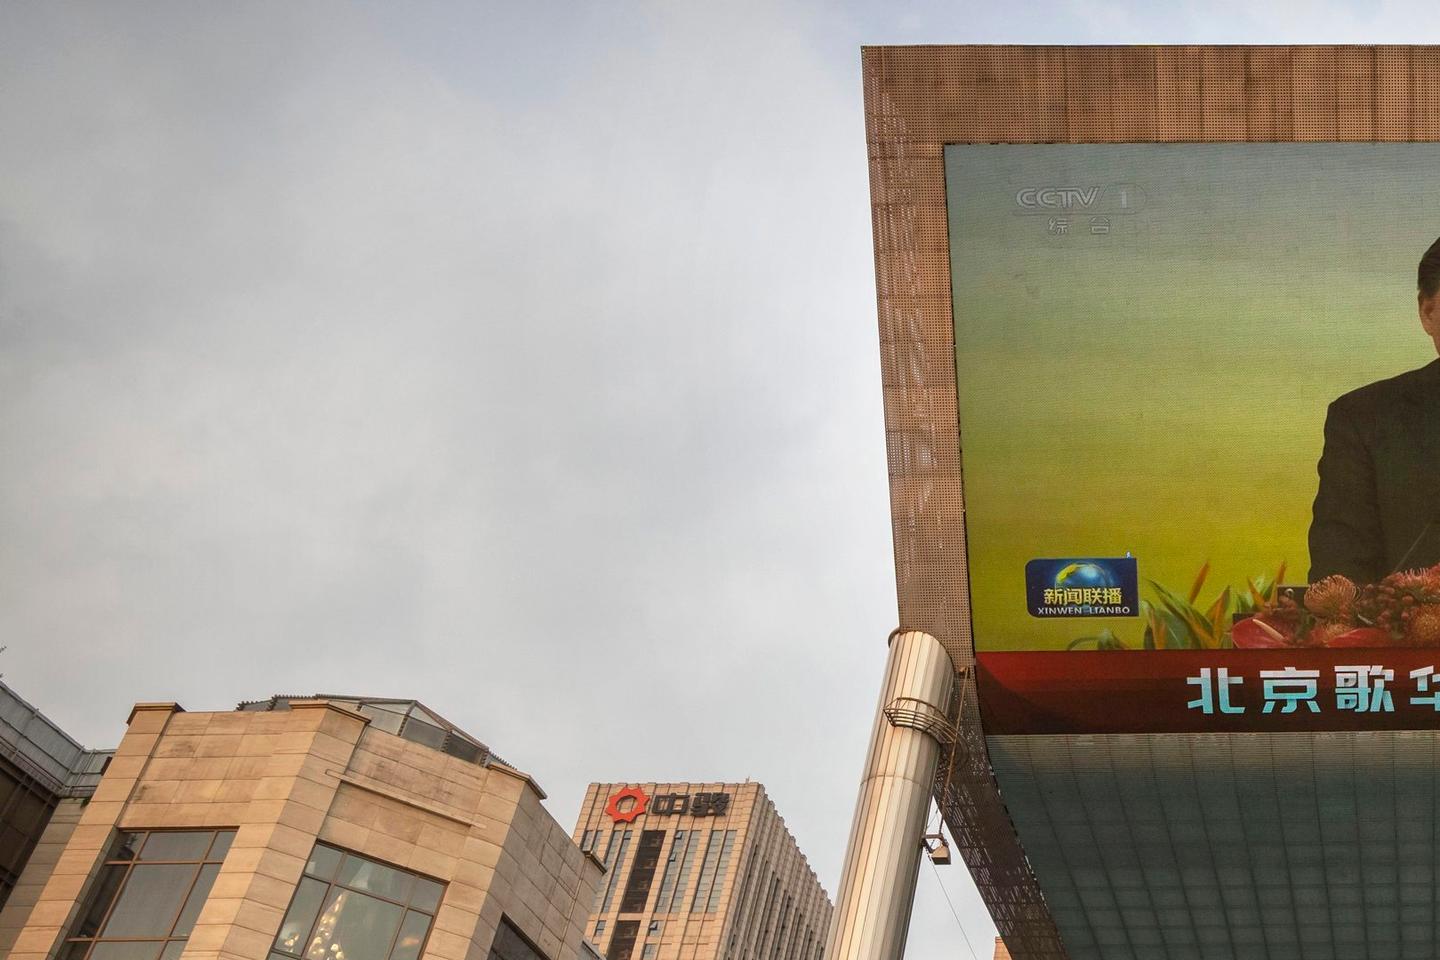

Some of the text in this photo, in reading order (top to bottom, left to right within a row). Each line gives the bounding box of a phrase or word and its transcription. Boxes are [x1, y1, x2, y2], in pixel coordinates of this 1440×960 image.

[1016, 186, 1100, 209] CCTV
[1043, 587, 1122, 606] 新闻联播
[1037, 605, 1131, 615] XINWEN LIANBO
